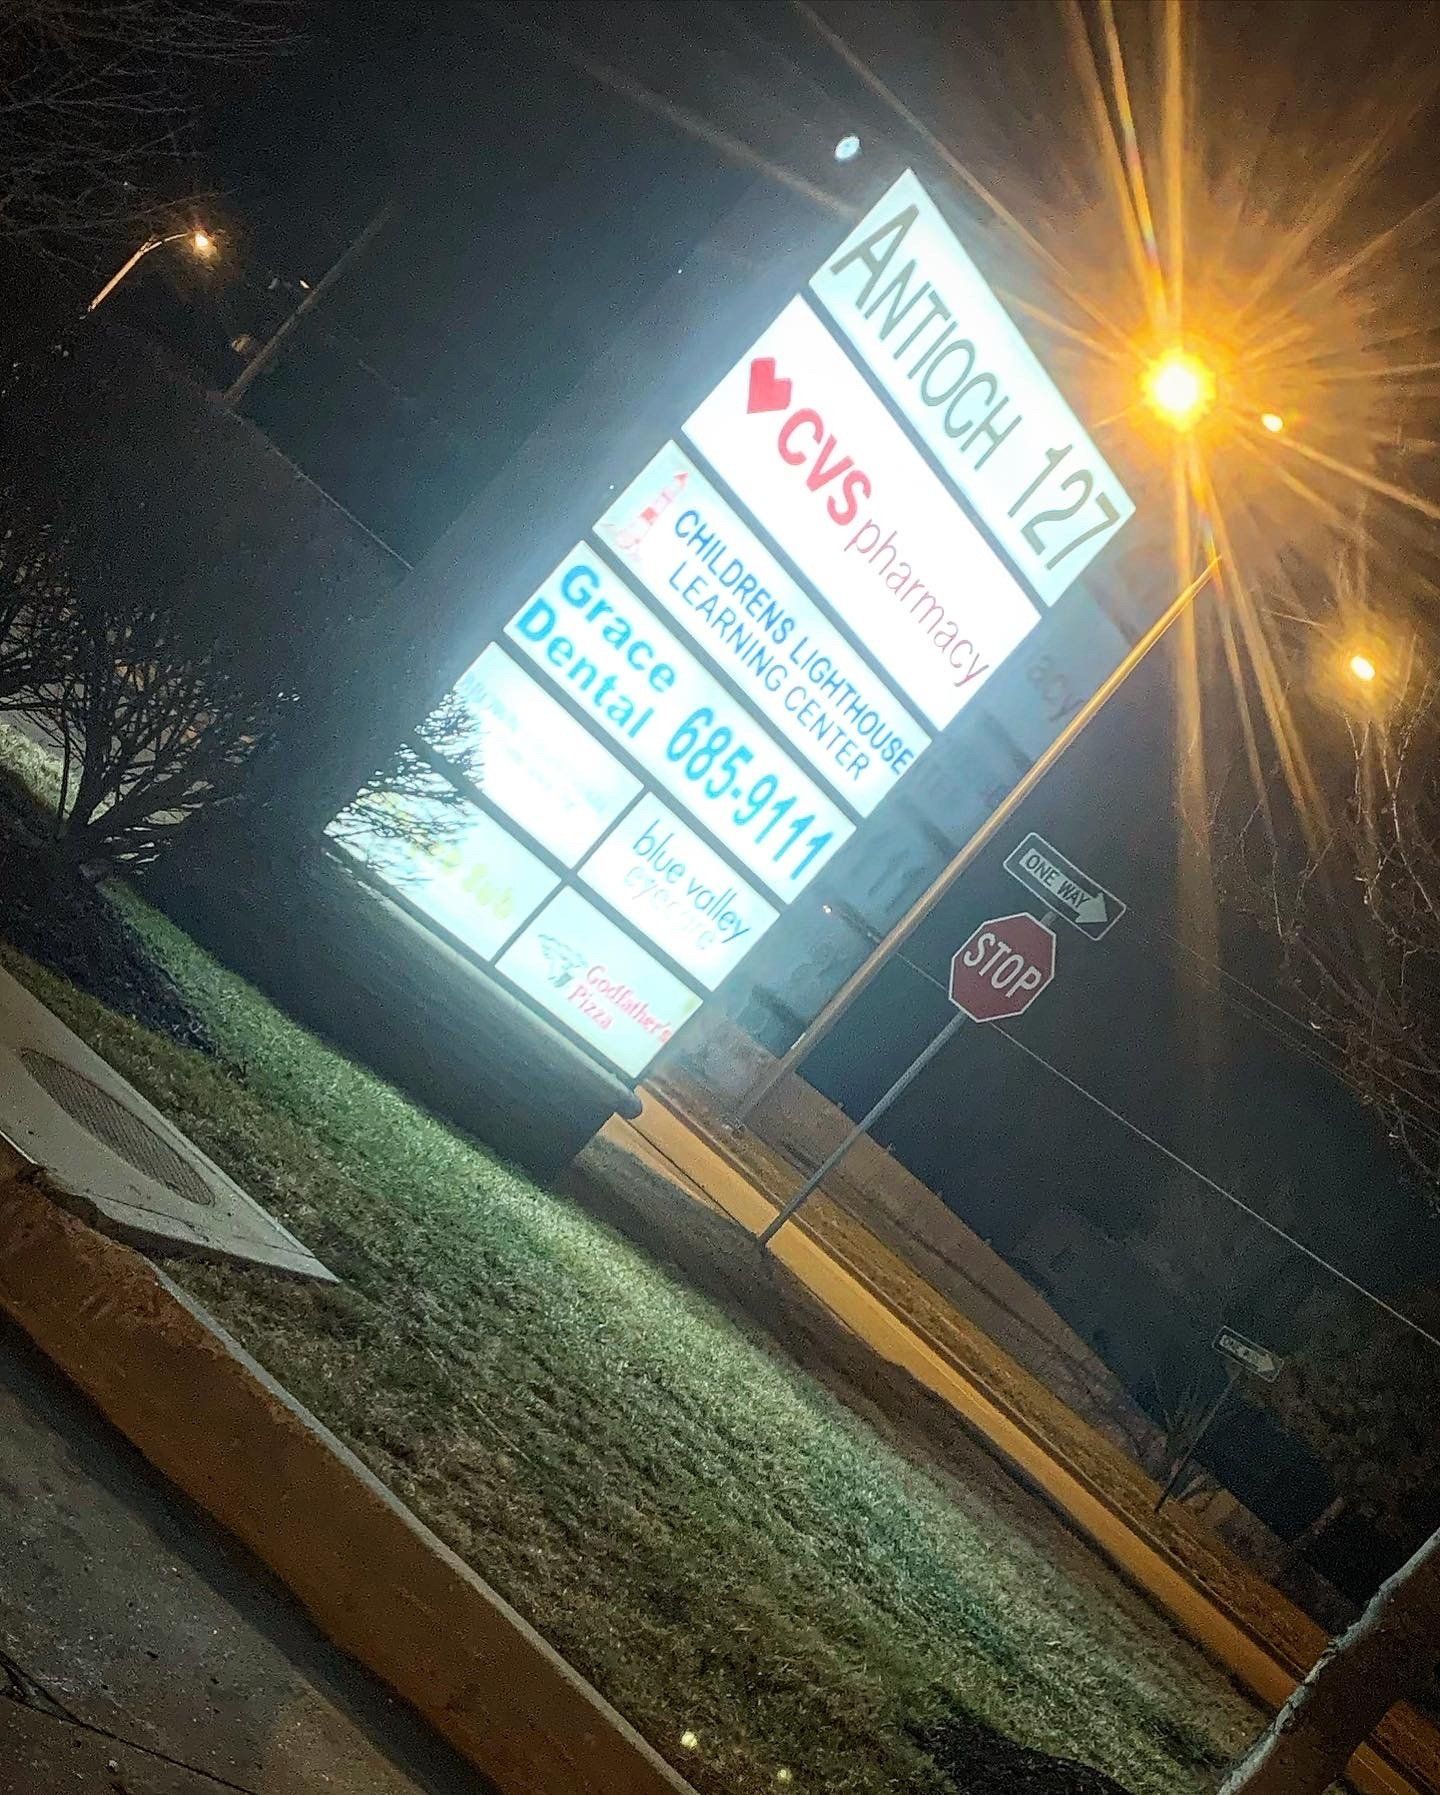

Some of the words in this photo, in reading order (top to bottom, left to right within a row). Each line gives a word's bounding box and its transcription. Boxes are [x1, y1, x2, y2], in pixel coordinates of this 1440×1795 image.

[830, 204, 1022, 470] ANTIOCH
[1008, 444, 1120, 570] 127
[777, 407, 871, 525] CVS
[844, 519, 990, 687] pharmacy
[516, 597, 654, 738] Dental
[561, 564, 676, 693] Grace
[669, 560, 787, 692] LEARNING
[784, 687, 872, 780] CENTER
[674, 510, 796, 644] CHILDRENS
[790, 636, 914, 775] LIGHTHOUSE
[632, 818, 686, 884] blue
[686, 877, 751, 943] valley
[1026, 854, 1056, 886] ONE
[1057, 880, 1089, 908] WAY
[568, 983, 614, 1030] Pizza
[964, 933, 1041, 998] STOP
